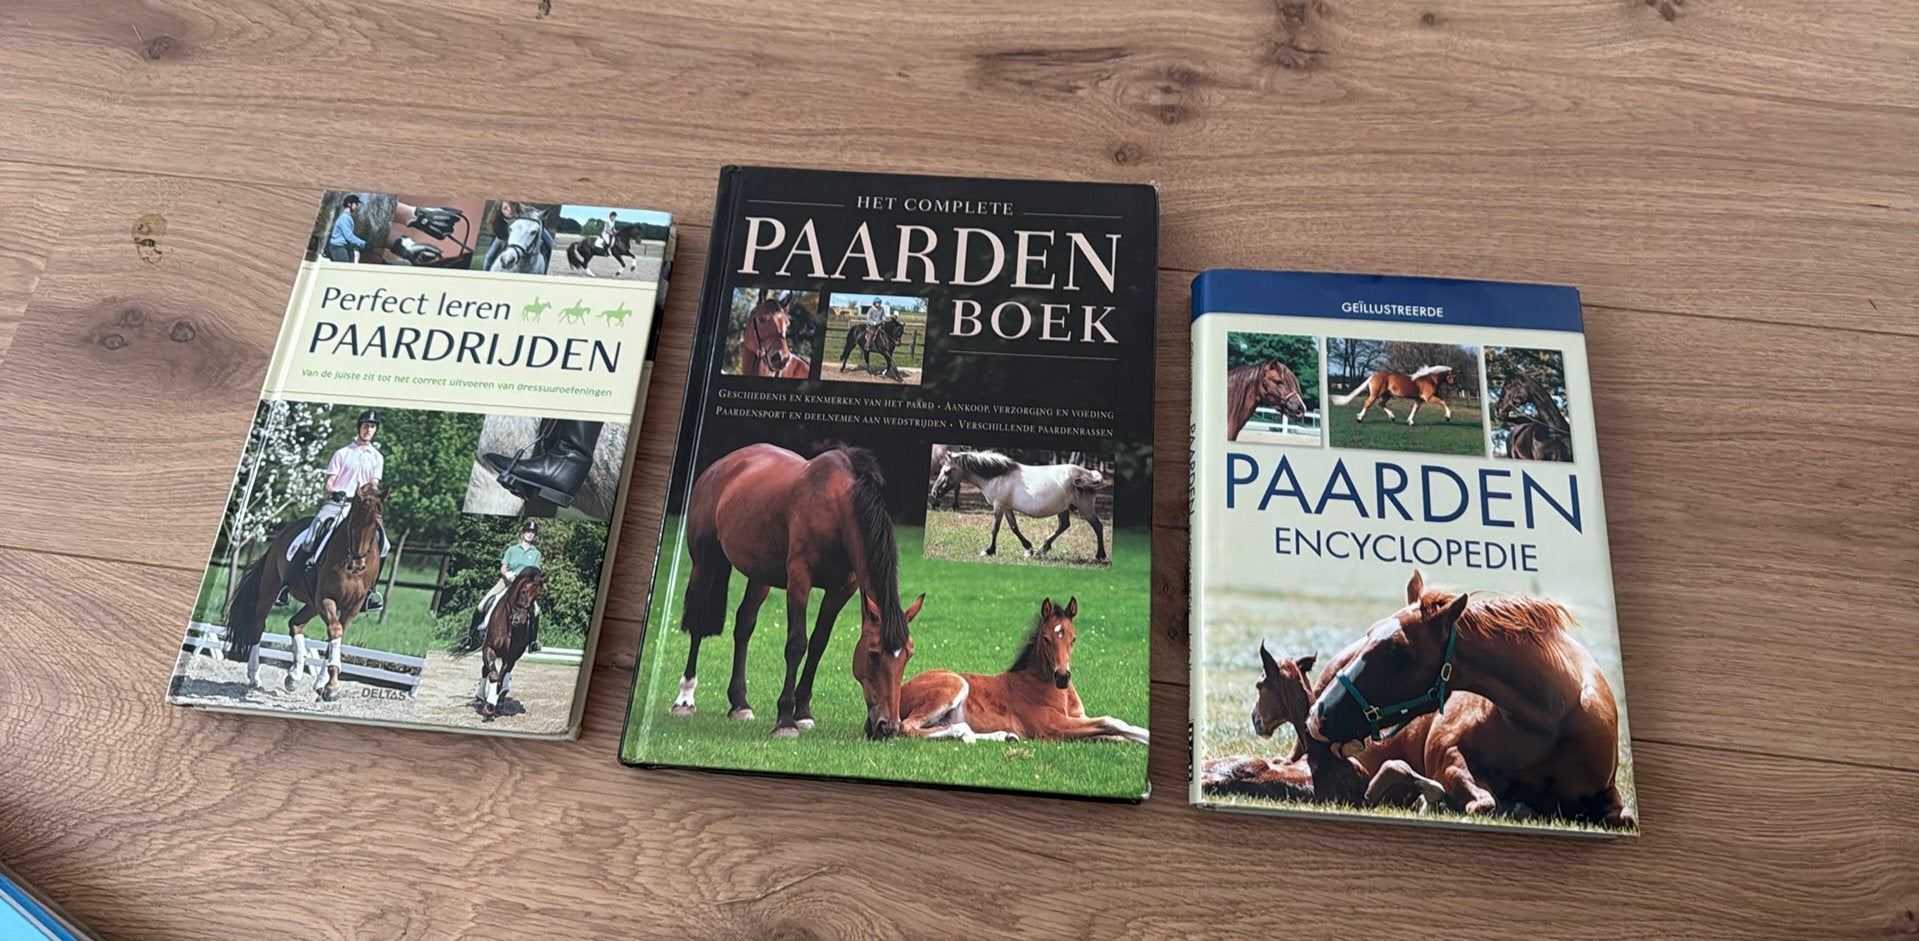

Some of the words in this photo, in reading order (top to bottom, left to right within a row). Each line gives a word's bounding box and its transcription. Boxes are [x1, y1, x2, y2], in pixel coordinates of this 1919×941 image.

[857, 195, 896, 210] HET
[904, 197, 1014, 216] COMPLETE
[737, 216, 1122, 293] PAARDEN
[321, 286, 429, 316] Perfect
[436, 292, 511, 321] leren
[1341, 299, 1444, 319] GEÏLLUSTREERDE
[949, 299, 1119, 344] BOEK
[308, 321, 621, 374] PAARDRIJDEN
[302, 368, 319, 378] Van
[321, 370, 333, 379] de
[335, 370, 361, 381] juiste
[363, 372, 375, 382] zit
[377, 373, 391, 383] tot
[394, 374, 410, 384] het
[412, 376, 447, 387] correct
[449, 378, 494, 390] uitvoeren
[498, 382, 514, 391] van
[517, 383, 613, 398] dressuuroefeningen
[789, 393, 801, 403] EN
[804, 395, 861, 406] KENMERKEN
[864, 398, 881, 407] VAN
[884, 399, 903, 408] HET
[906, 401, 935, 410] PAARD
[993, 405, 1054, 417] VERZORGING
[1056, 408, 1069, 417] EN
[1071, 409, 1115, 420] VOEDING
[789, 411, 801, 420] EN
[804, 412, 861, 424] DEELNEMEN
[862, 415, 881, 425] AAN
[883, 416, 947, 429] WEDSTRIJDEN
[1038, 426, 1114, 438] PAARDENRASSEN
[1226, 452, 1583, 535] PAARDEN
[1275, 527, 1539, 572] ENCYCLOPEDIE
[361, 687, 406, 701] DELTAS
